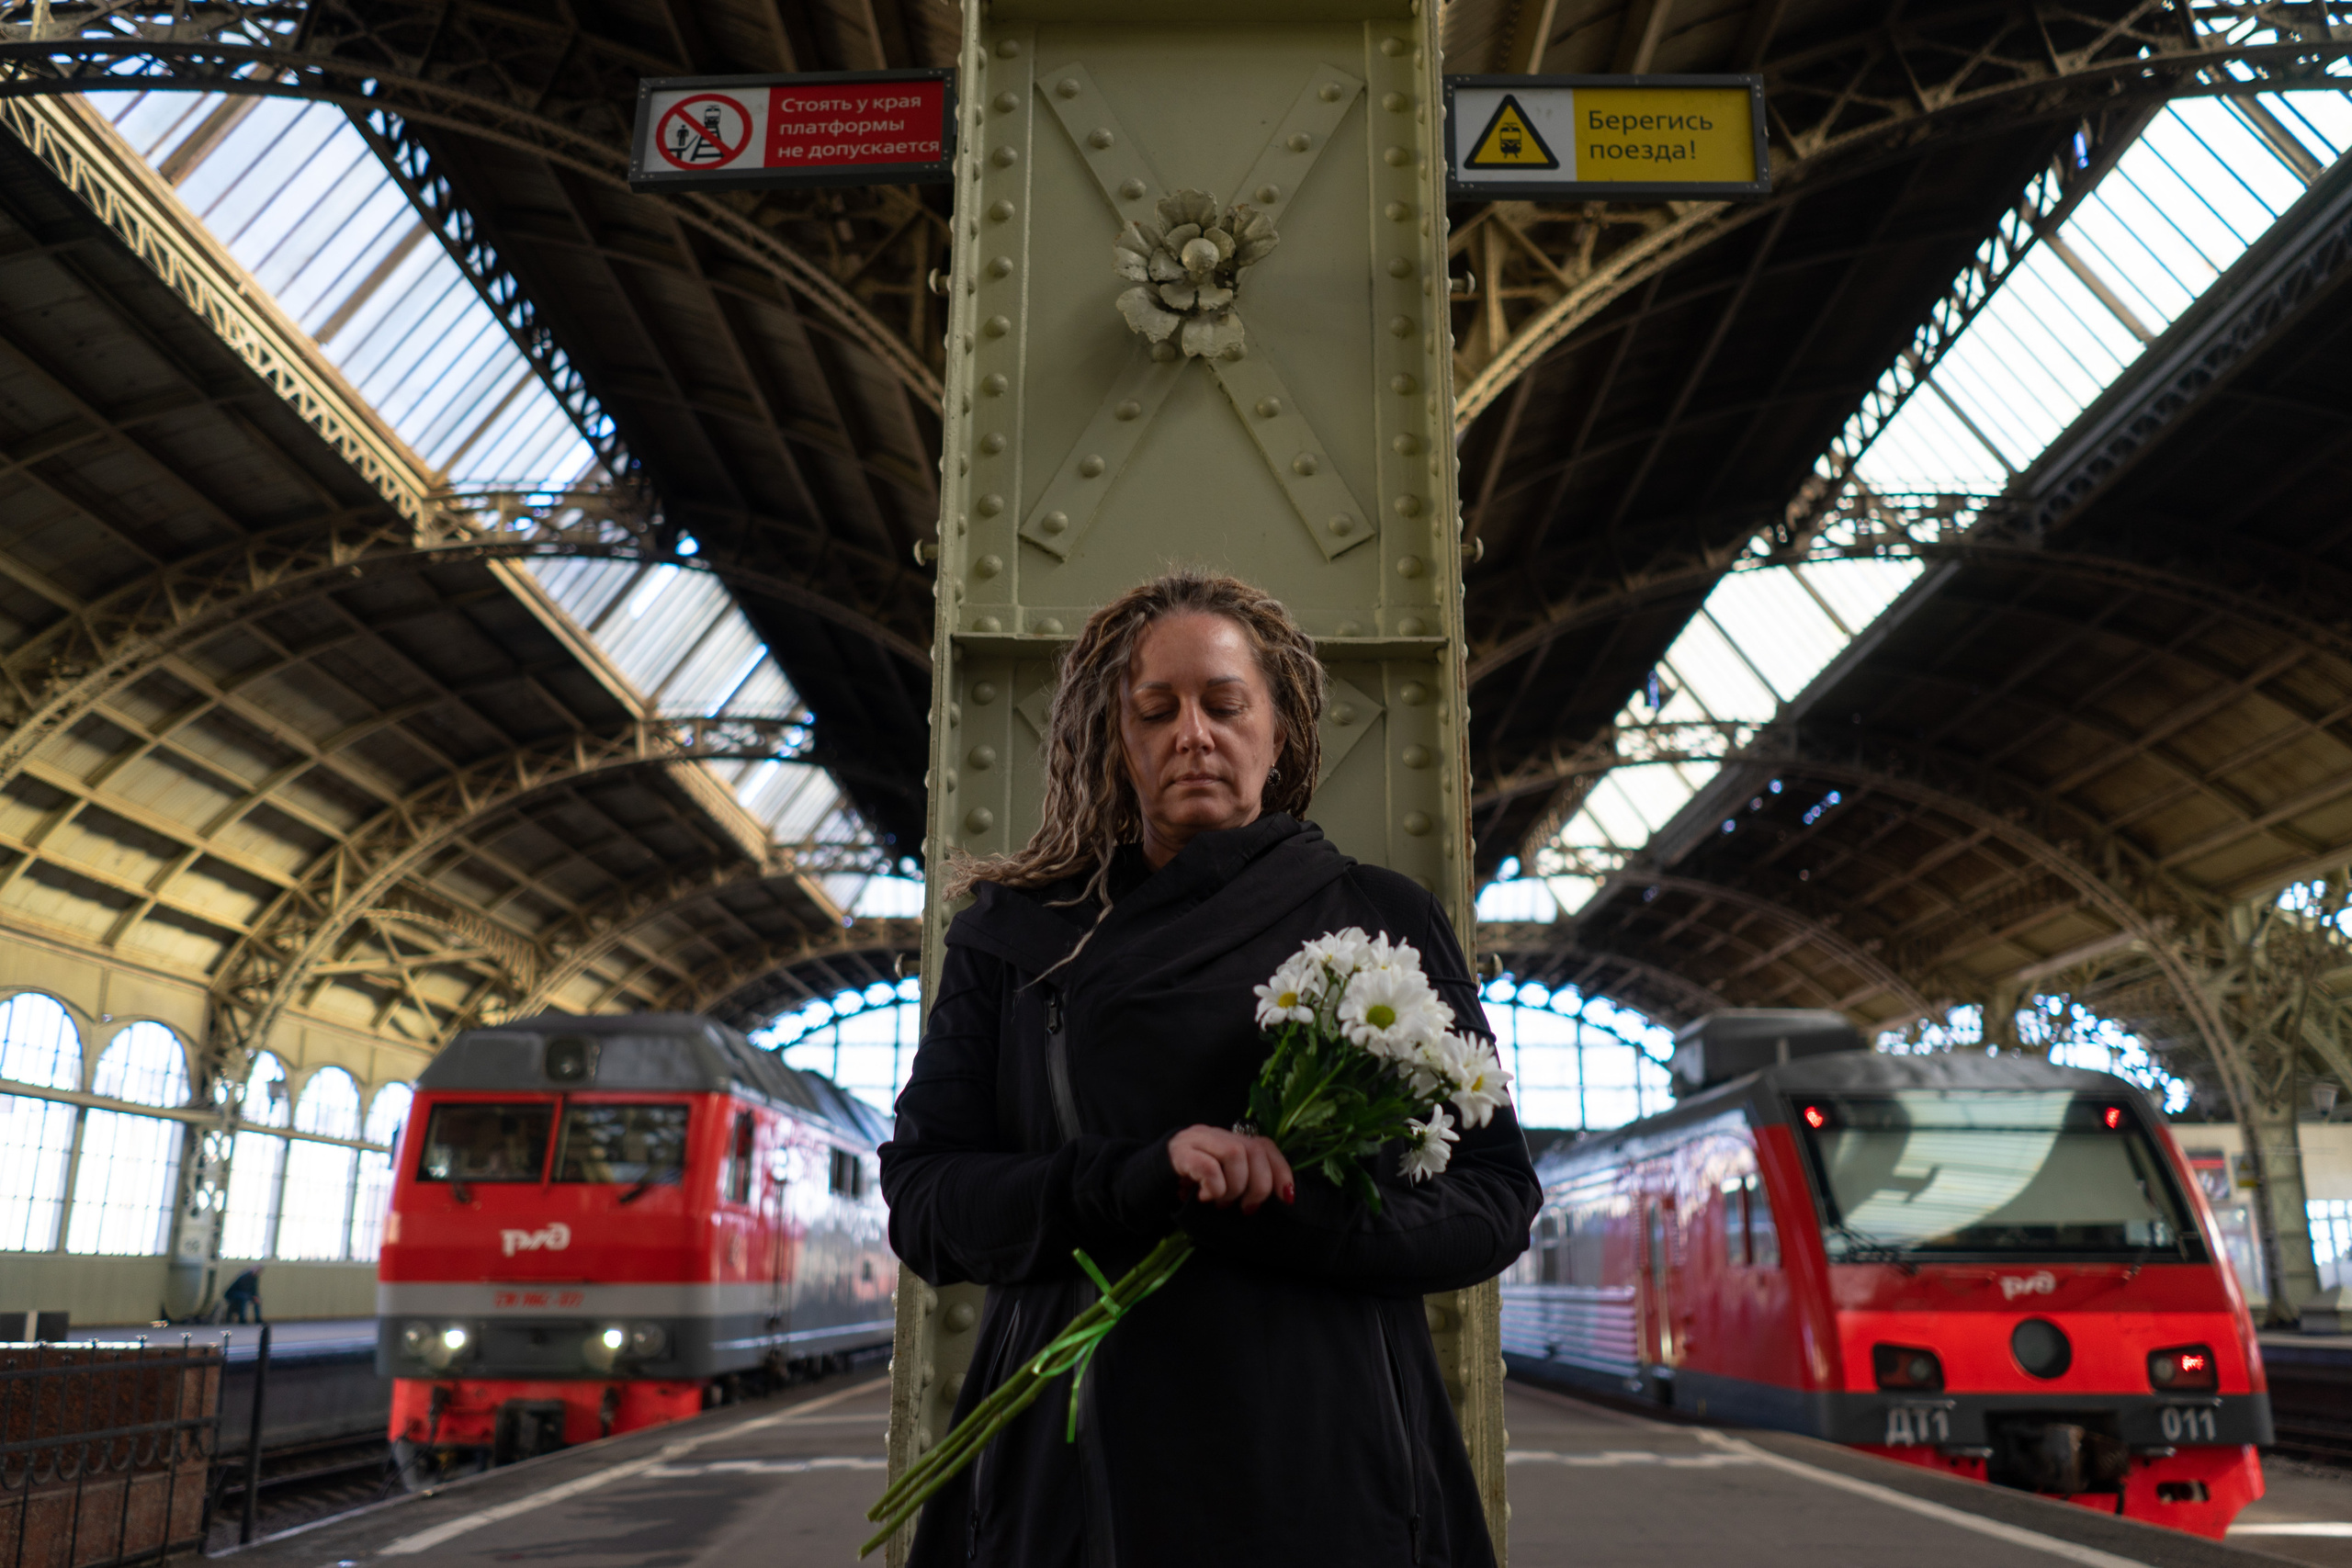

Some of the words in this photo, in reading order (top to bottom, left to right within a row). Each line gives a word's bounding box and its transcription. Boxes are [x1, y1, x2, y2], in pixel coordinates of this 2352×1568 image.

[781, 97, 853, 113] Стоять
[855, 98, 869, 114] у
[873, 96, 922, 112] края
[779, 119, 905, 137] платформы
[1589, 110, 1713, 135] Берегись
[777, 145, 804, 158] не
[808, 141, 940, 160] допускается
[1589, 141, 1696, 163] поезда!
[1885, 1407, 1949, 1448] ДТ1
[2161, 1407, 2217, 1442] 011
